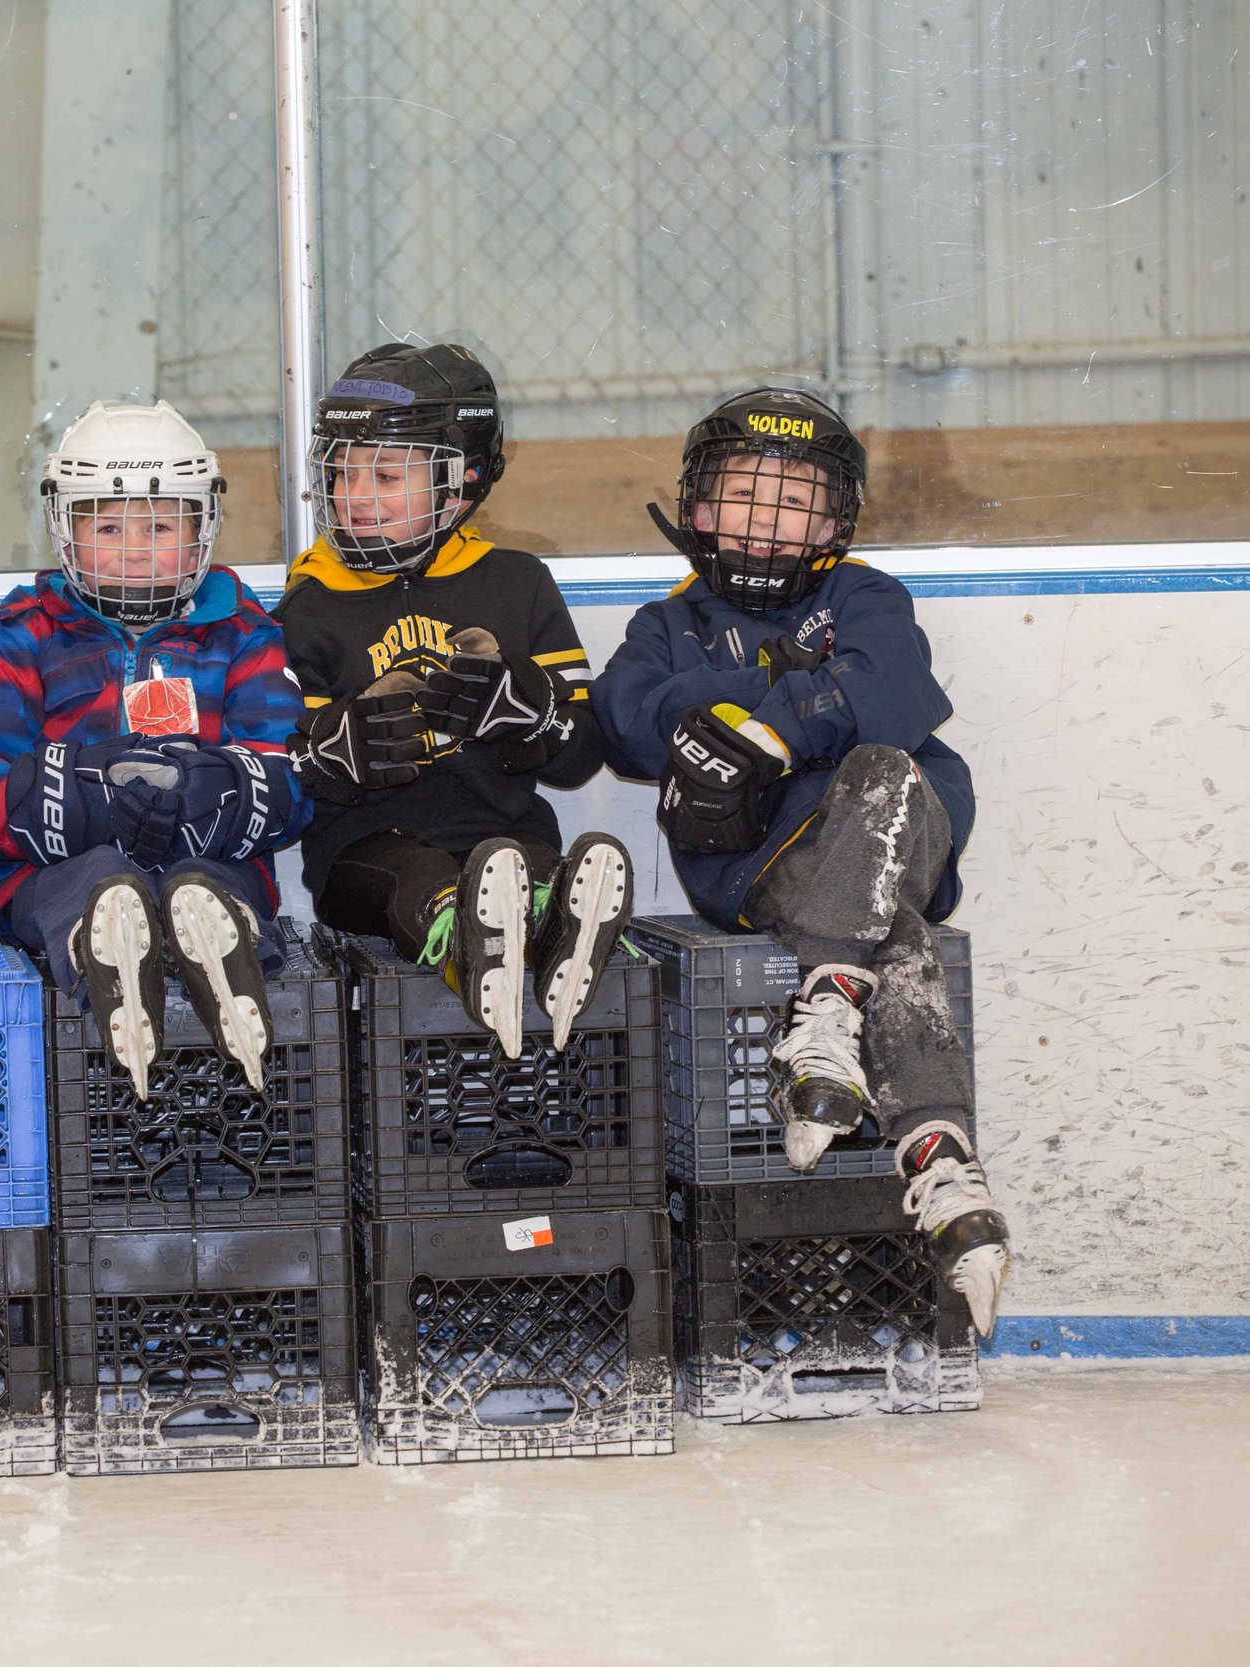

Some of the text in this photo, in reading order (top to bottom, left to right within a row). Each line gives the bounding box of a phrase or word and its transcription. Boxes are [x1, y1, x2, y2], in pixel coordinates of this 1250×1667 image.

[326, 410, 372, 419] BAUER
[457, 408, 494, 417] BAUER
[748, 414, 815, 440] HOLDEN
[105, 461, 163, 470] BAUER
[730, 573, 786, 588] CCM
